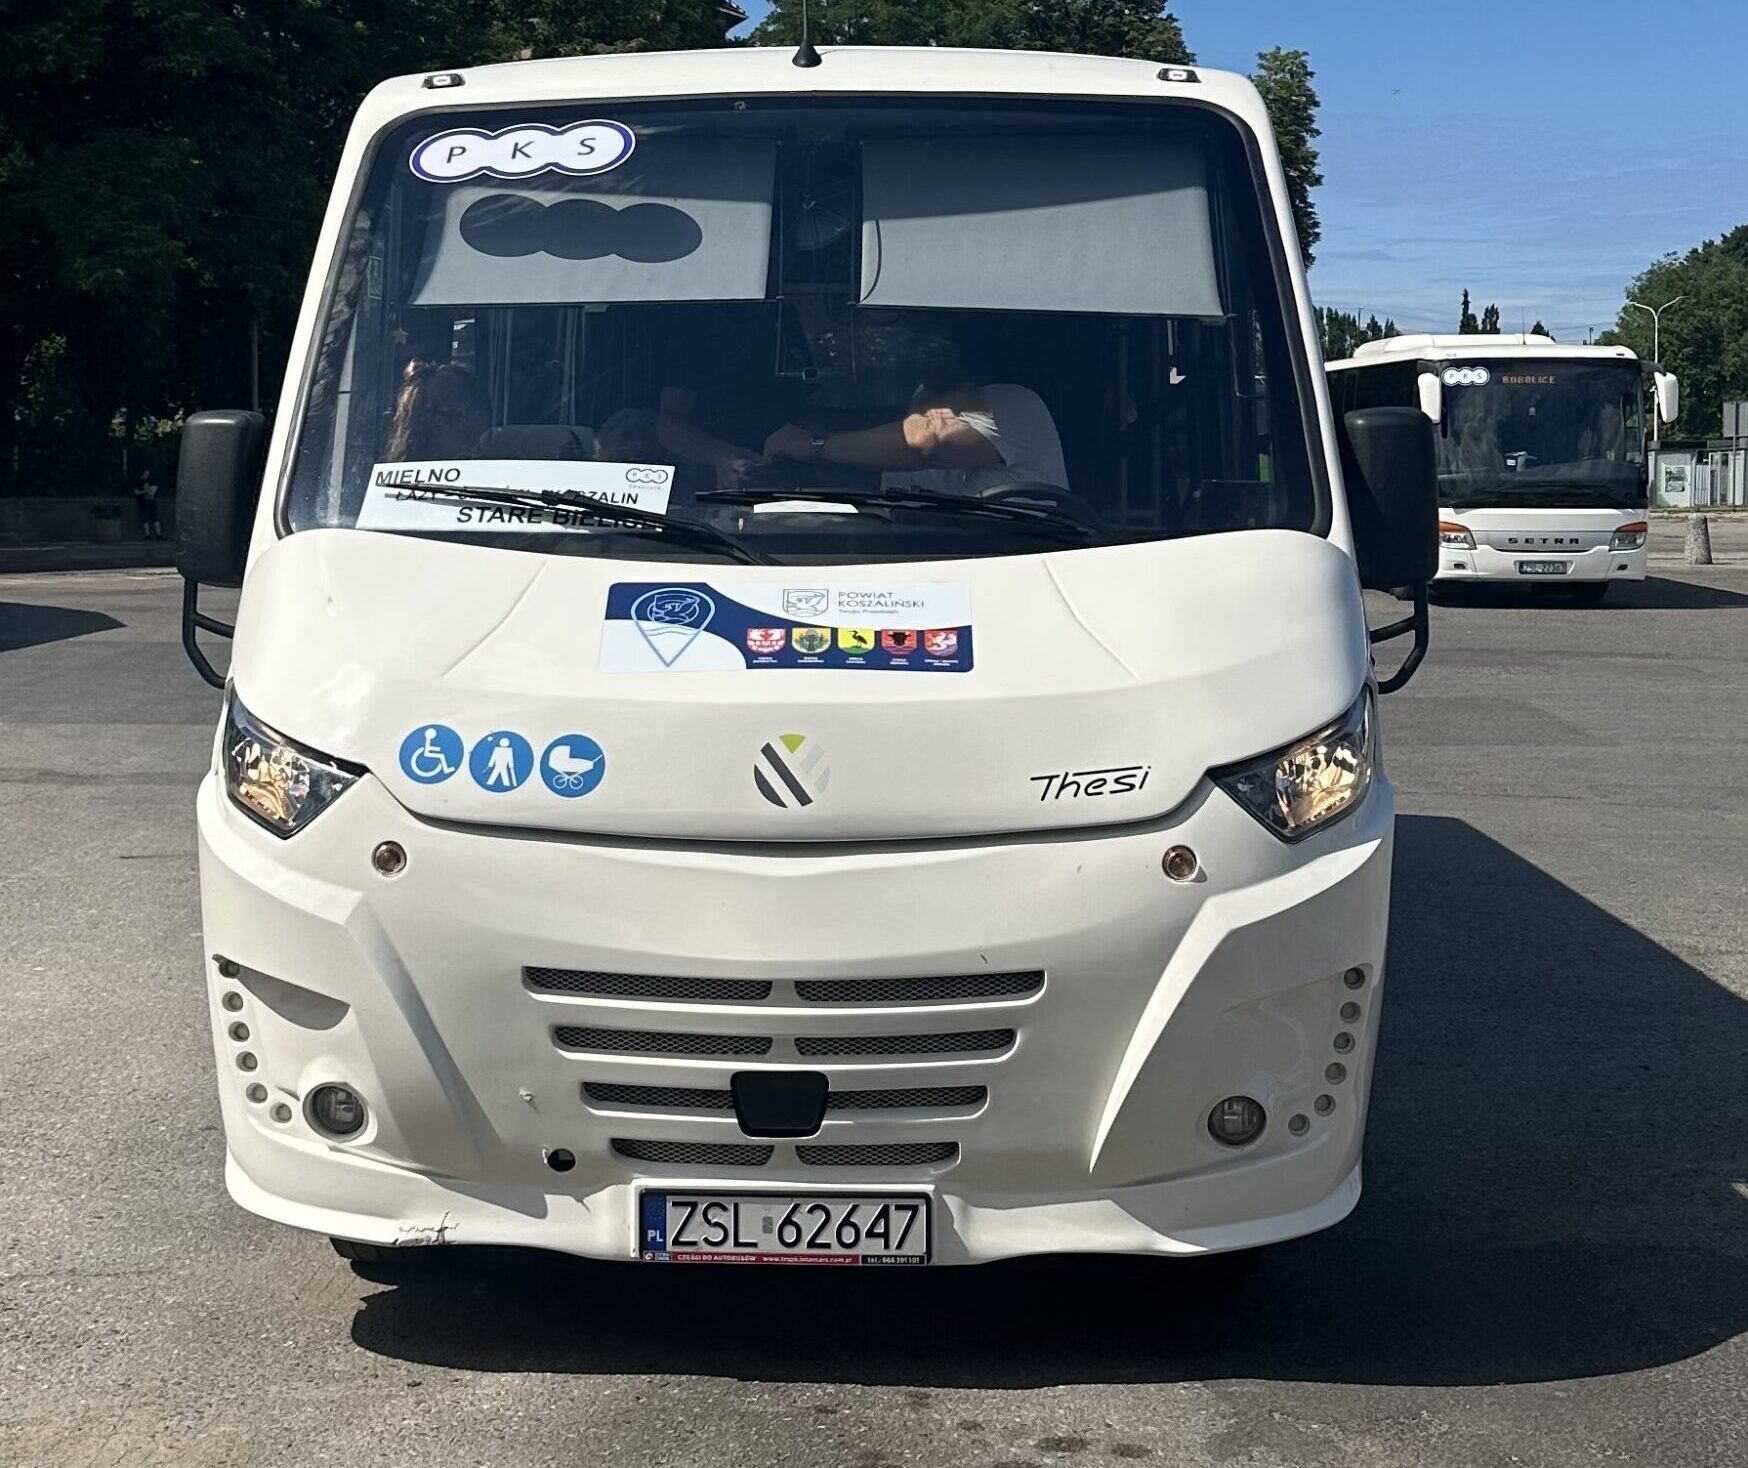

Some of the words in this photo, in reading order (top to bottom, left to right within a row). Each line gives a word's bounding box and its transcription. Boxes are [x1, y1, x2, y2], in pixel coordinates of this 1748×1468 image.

[446, 137, 596, 163] PKS
[375, 468, 461, 485] MIELNO
[456, 505, 542, 524] STARE
[838, 591, 893, 599] POWIAT
[838, 599, 924, 608] KOSZALIŃSKI
[1030, 765, 1151, 801] Thesi
[671, 1200, 758, 1248] ZSL
[777, 1202, 920, 1251] 62647
[647, 1229, 664, 1242] PL
